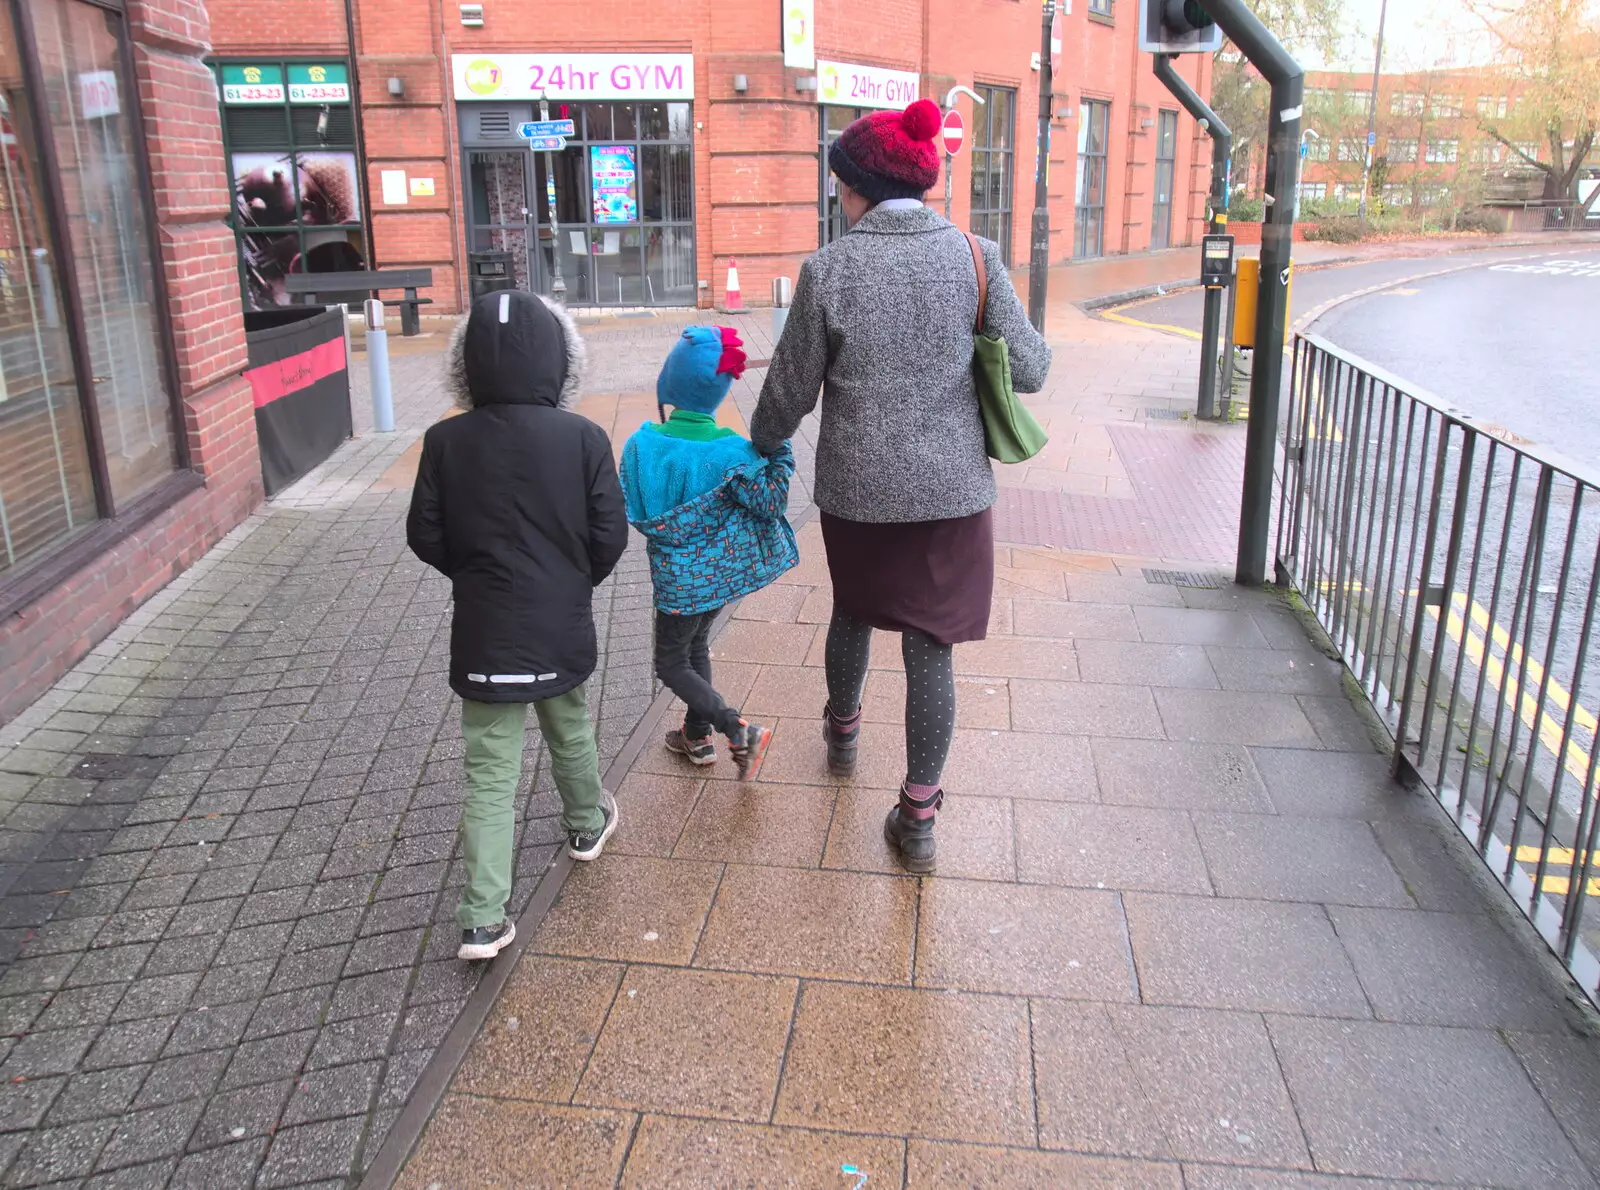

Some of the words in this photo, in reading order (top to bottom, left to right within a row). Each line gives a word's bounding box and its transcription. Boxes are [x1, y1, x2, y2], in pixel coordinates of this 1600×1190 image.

[529, 63, 599, 90] 24hr
[610, 64, 683, 90] GYM
[226, 87, 281, 99] 61-23-23
[291, 87, 346, 98] 61-23-23
[850, 73, 882, 99] 24hr
[885, 79, 915, 102] GYM
